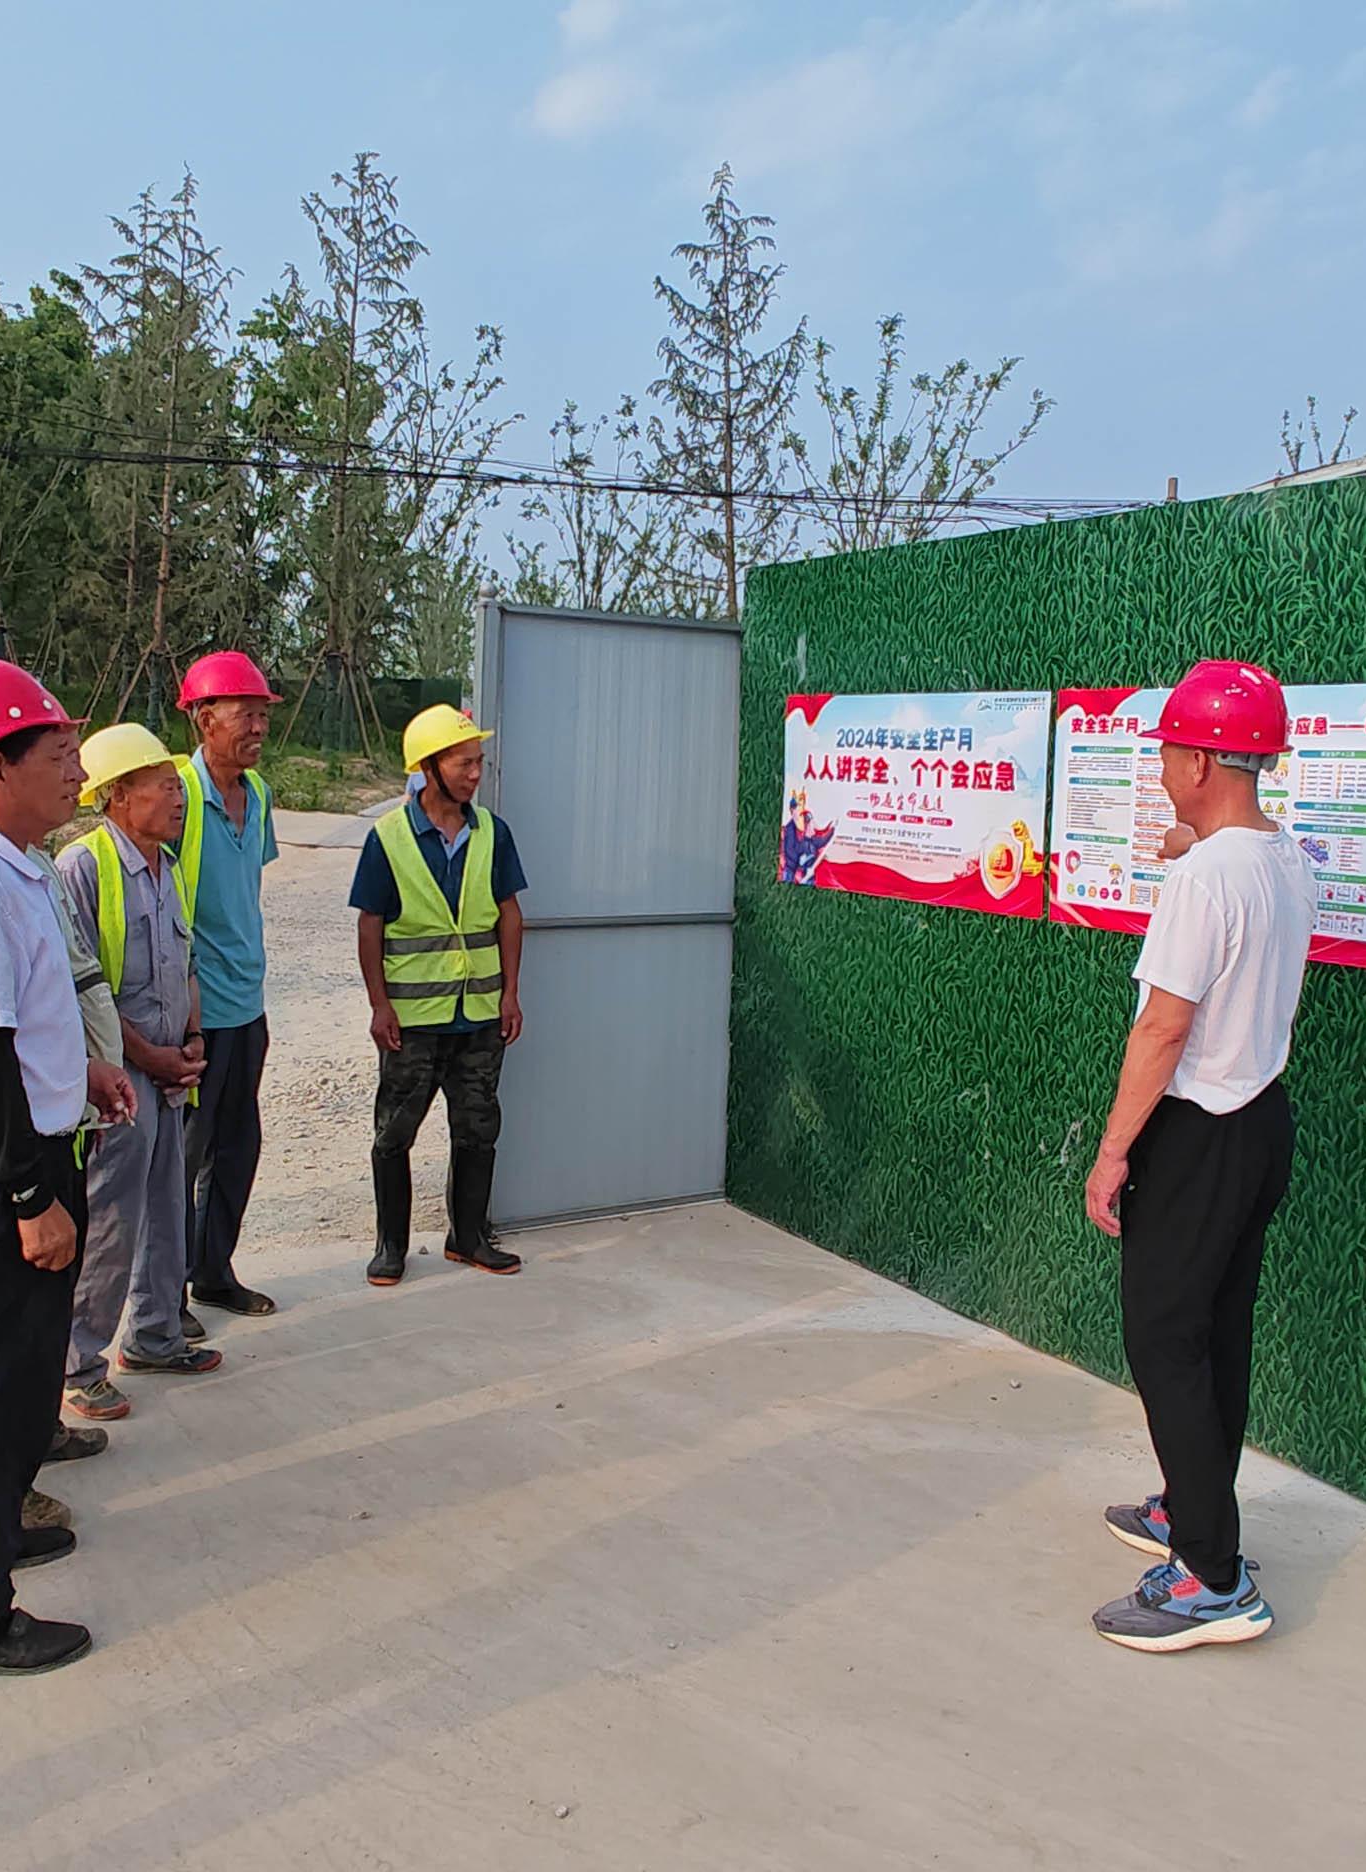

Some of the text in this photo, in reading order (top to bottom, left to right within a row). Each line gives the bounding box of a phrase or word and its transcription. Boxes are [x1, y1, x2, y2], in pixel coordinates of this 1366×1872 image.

[836, 725, 973, 752] 2024年安全生产月
[803, 754, 1016, 792] 人人讲安全、个个会应急
